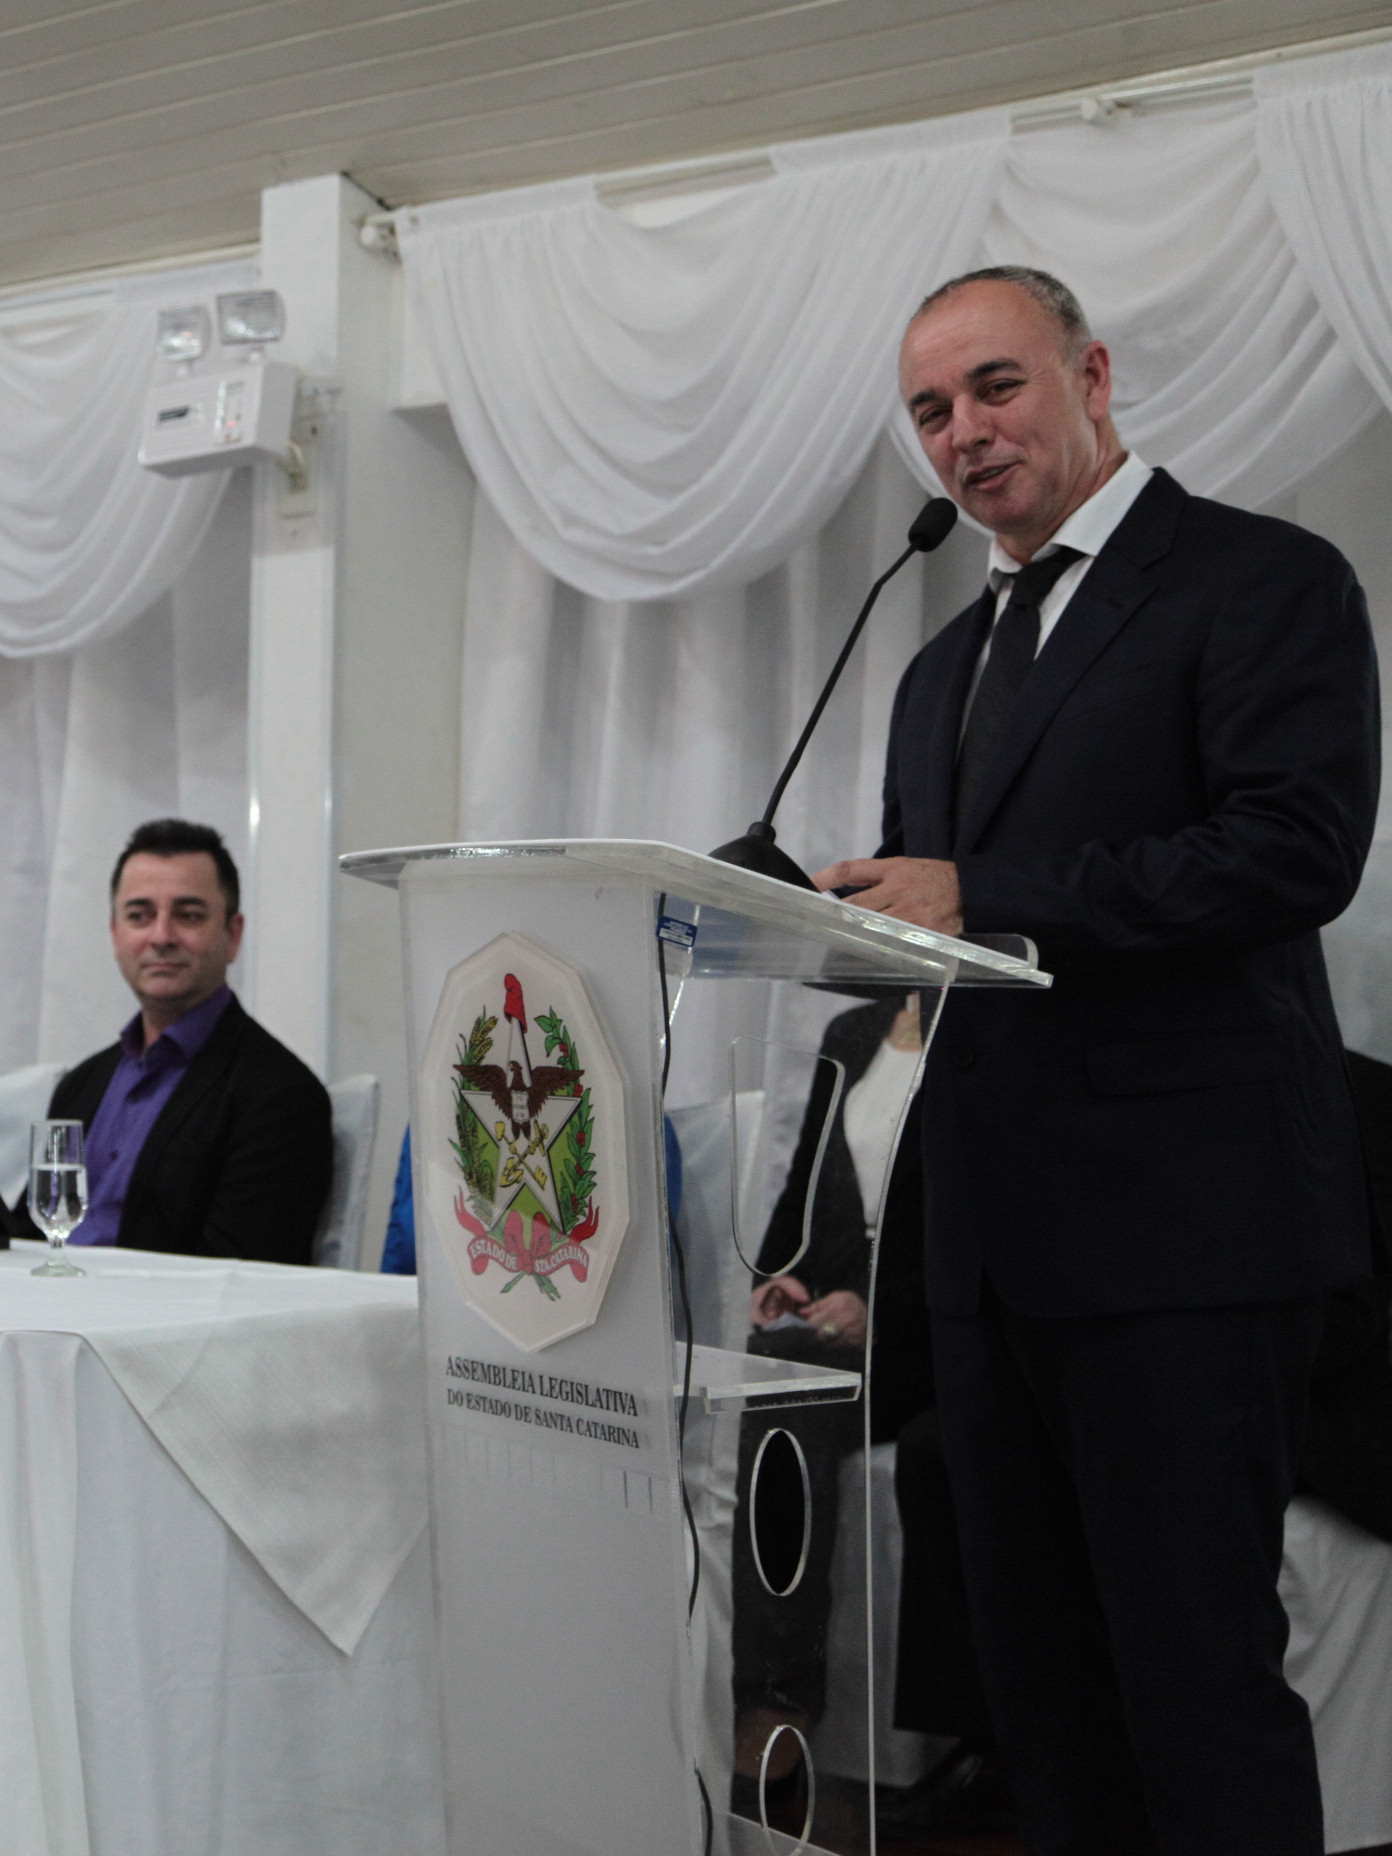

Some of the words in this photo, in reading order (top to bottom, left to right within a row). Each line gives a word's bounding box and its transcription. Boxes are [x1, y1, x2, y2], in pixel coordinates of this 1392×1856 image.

[470, 1239, 506, 1263] ESTADO
[505, 1254, 518, 1270] DE
[446, 1355, 536, 1394] ASSEMBLEIA
[538, 1375, 638, 1417] LEGISLATIVA
[447, 1388, 464, 1407] DO
[466, 1392, 512, 1418] ESTADO
[514, 1404, 532, 1423] DE
[534, 1408, 574, 1433] SANTA
[576, 1418, 640, 1449] CATARINA
